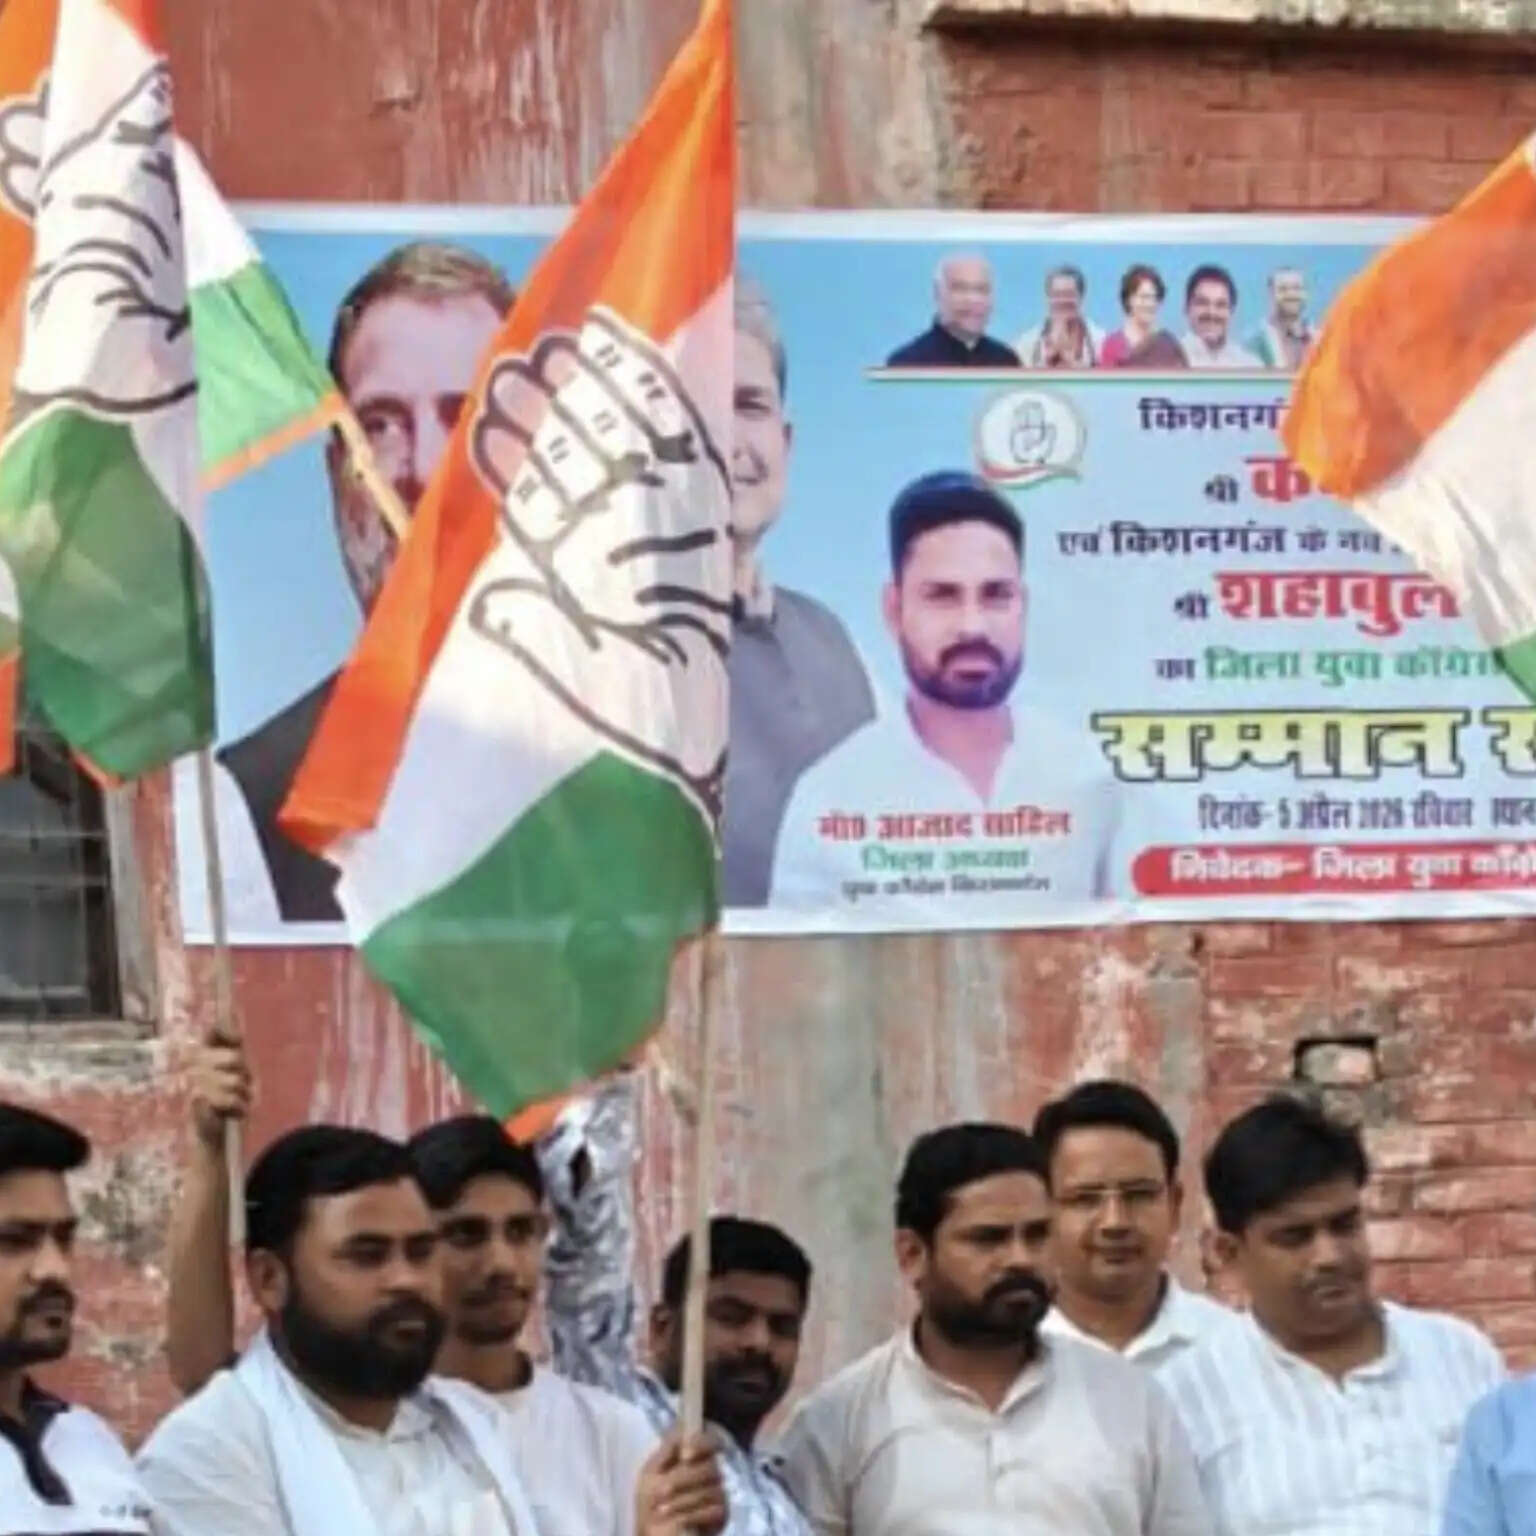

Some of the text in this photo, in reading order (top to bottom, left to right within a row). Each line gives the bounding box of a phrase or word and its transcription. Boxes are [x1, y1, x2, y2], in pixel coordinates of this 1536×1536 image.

[1139, 398, 1286, 431] किशनगं
[1111, 520, 1285, 554] किशनगंज
[1204, 646, 1301, 679] जिला
[1316, 651, 1380, 687] युवा
[1091, 709, 1471, 781] सम्मान
[1311, 846, 1397, 879] जिला
